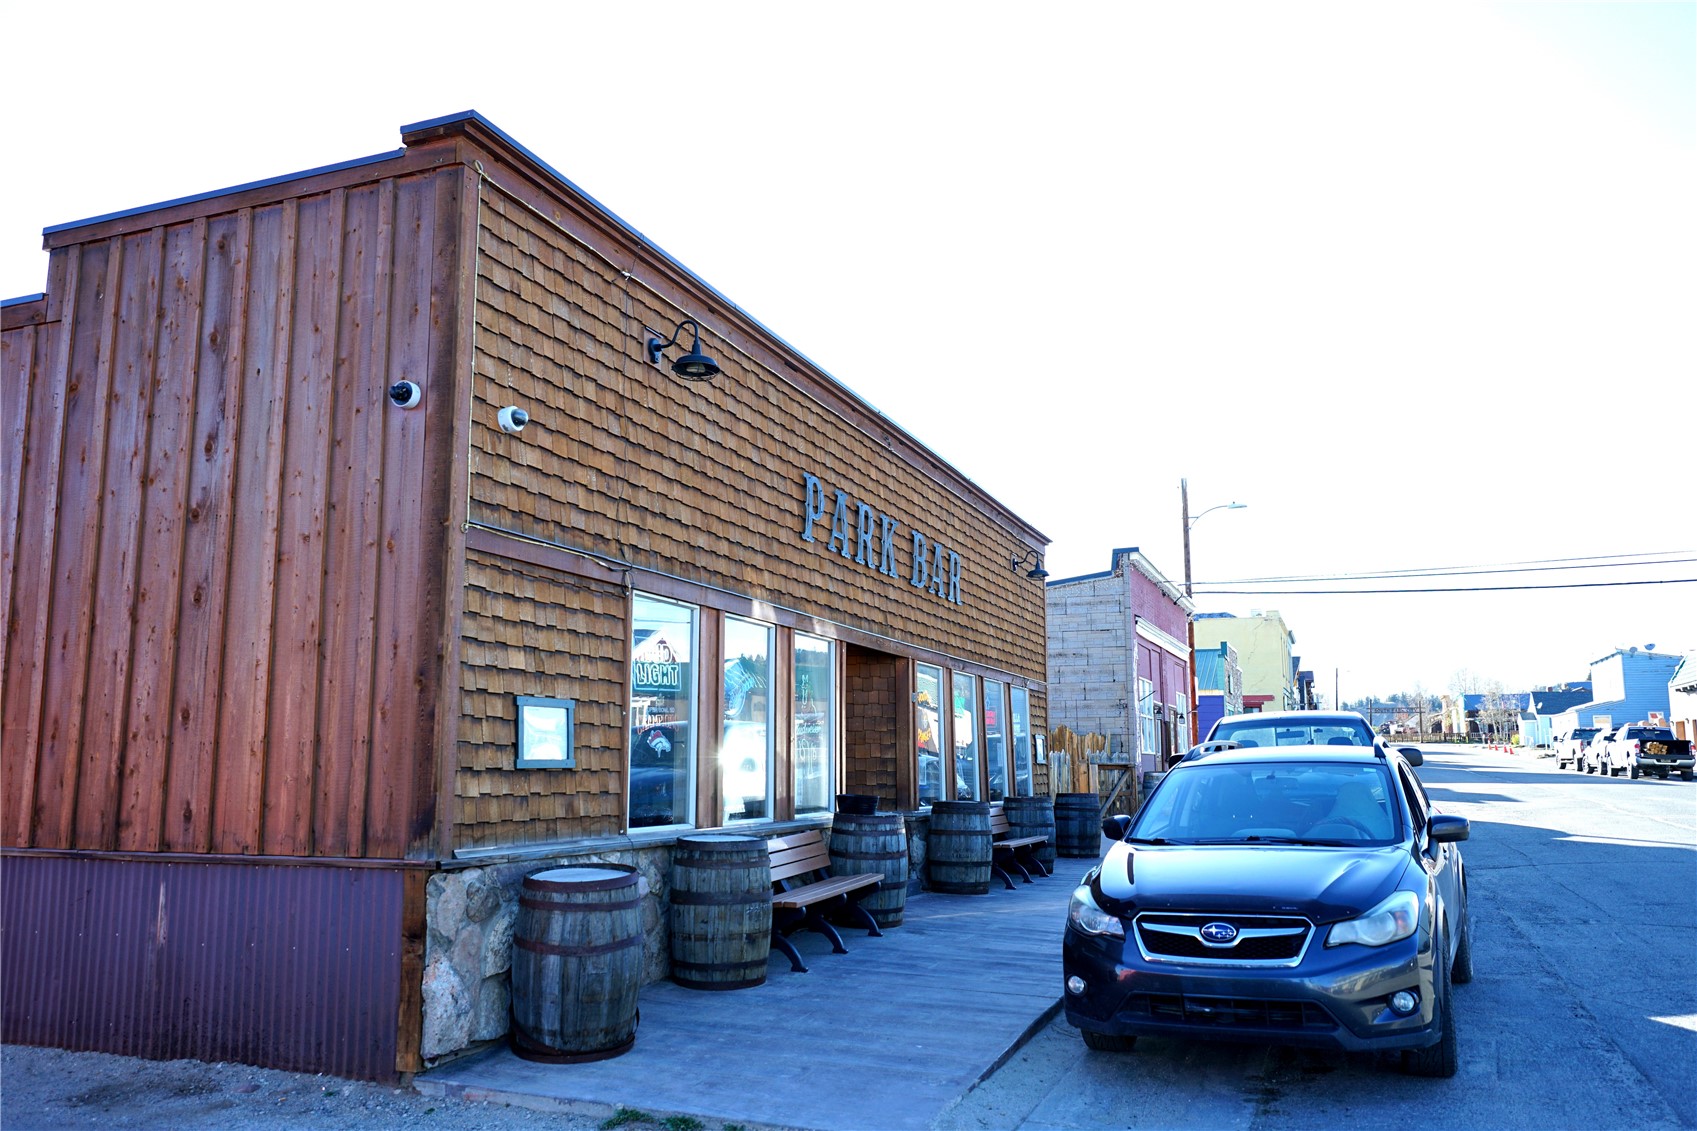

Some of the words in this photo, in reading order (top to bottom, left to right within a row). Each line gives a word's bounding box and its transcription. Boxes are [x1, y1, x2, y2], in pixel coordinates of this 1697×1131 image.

[801, 472, 900, 579] PARK
[909, 530, 963, 606] BAR
[636, 664, 679, 686] LIGHT
